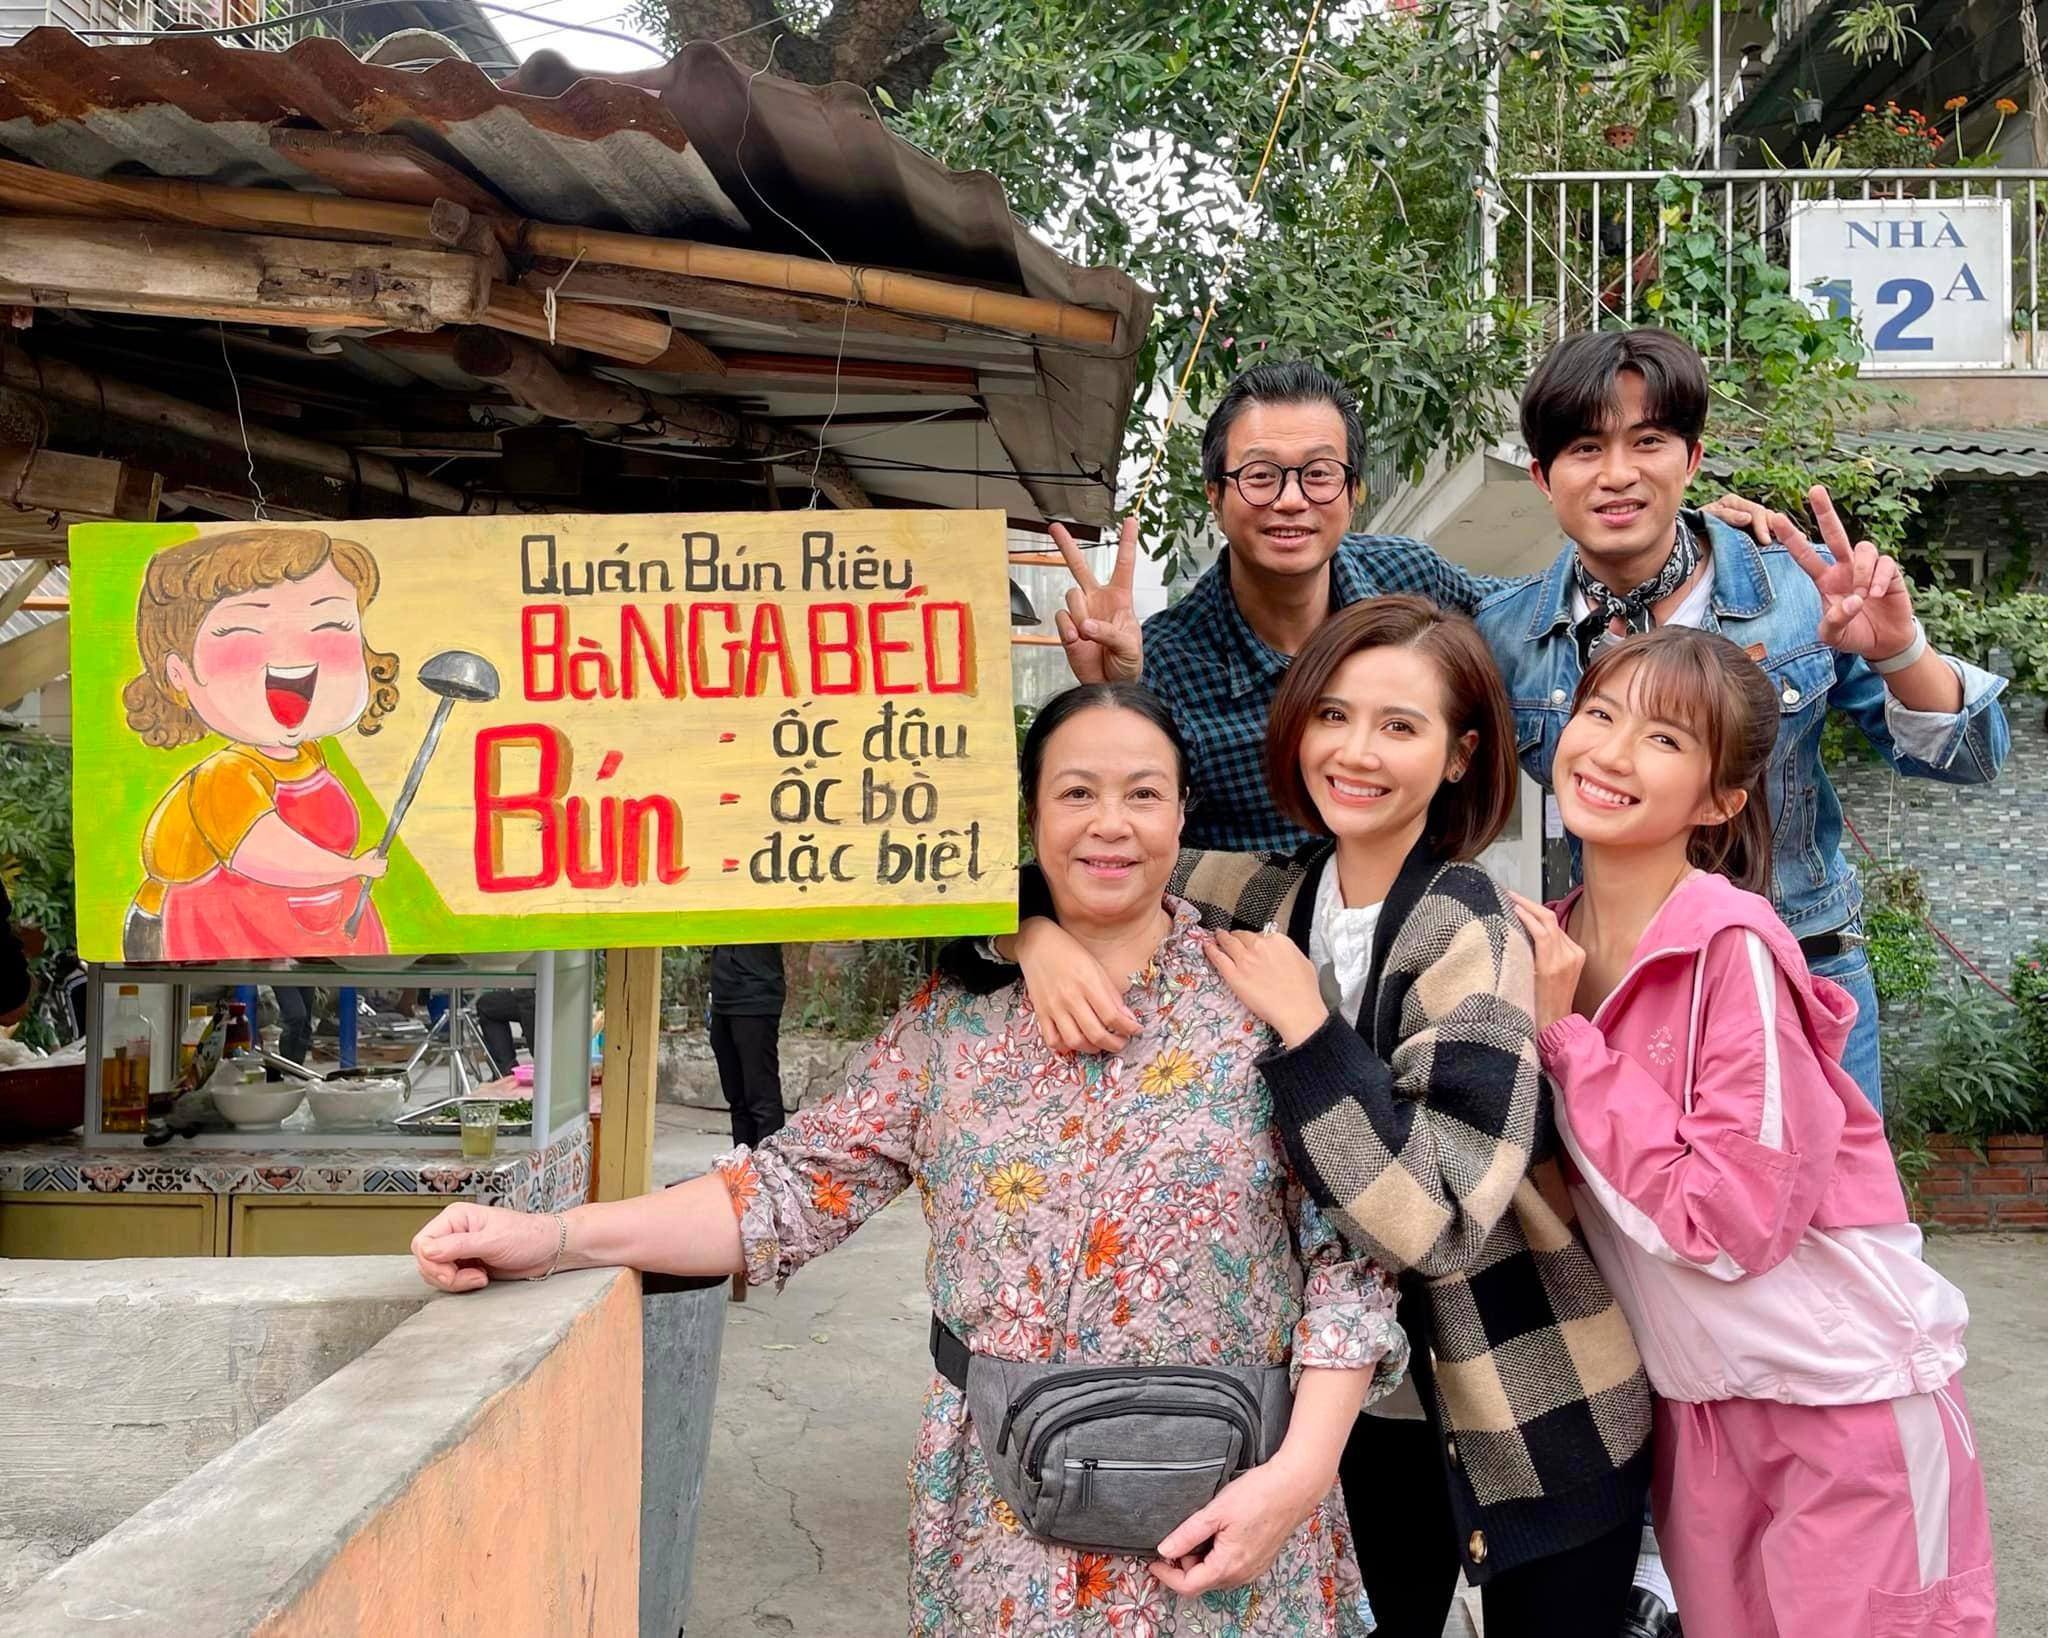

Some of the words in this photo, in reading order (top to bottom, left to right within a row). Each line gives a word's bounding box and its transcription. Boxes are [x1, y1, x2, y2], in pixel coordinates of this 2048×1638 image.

[1845, 211, 1968, 249] NHÀ
[520, 534, 675, 596] Quán
[682, 531, 786, 593] Bún
[802, 531, 913, 592] Riêu
[521, 604, 619, 701] Bà
[620, 602, 800, 700] NGA
[807, 585, 978, 697] BÉO
[772, 701, 842, 759] ốc
[862, 700, 970, 767] đậu
[474, 722, 690, 893] Bún
[770, 759, 843, 825] ốc
[862, 767, 939, 825] bò
[749, 830, 857, 893] đặc
[876, 820, 986, 894] biệt
